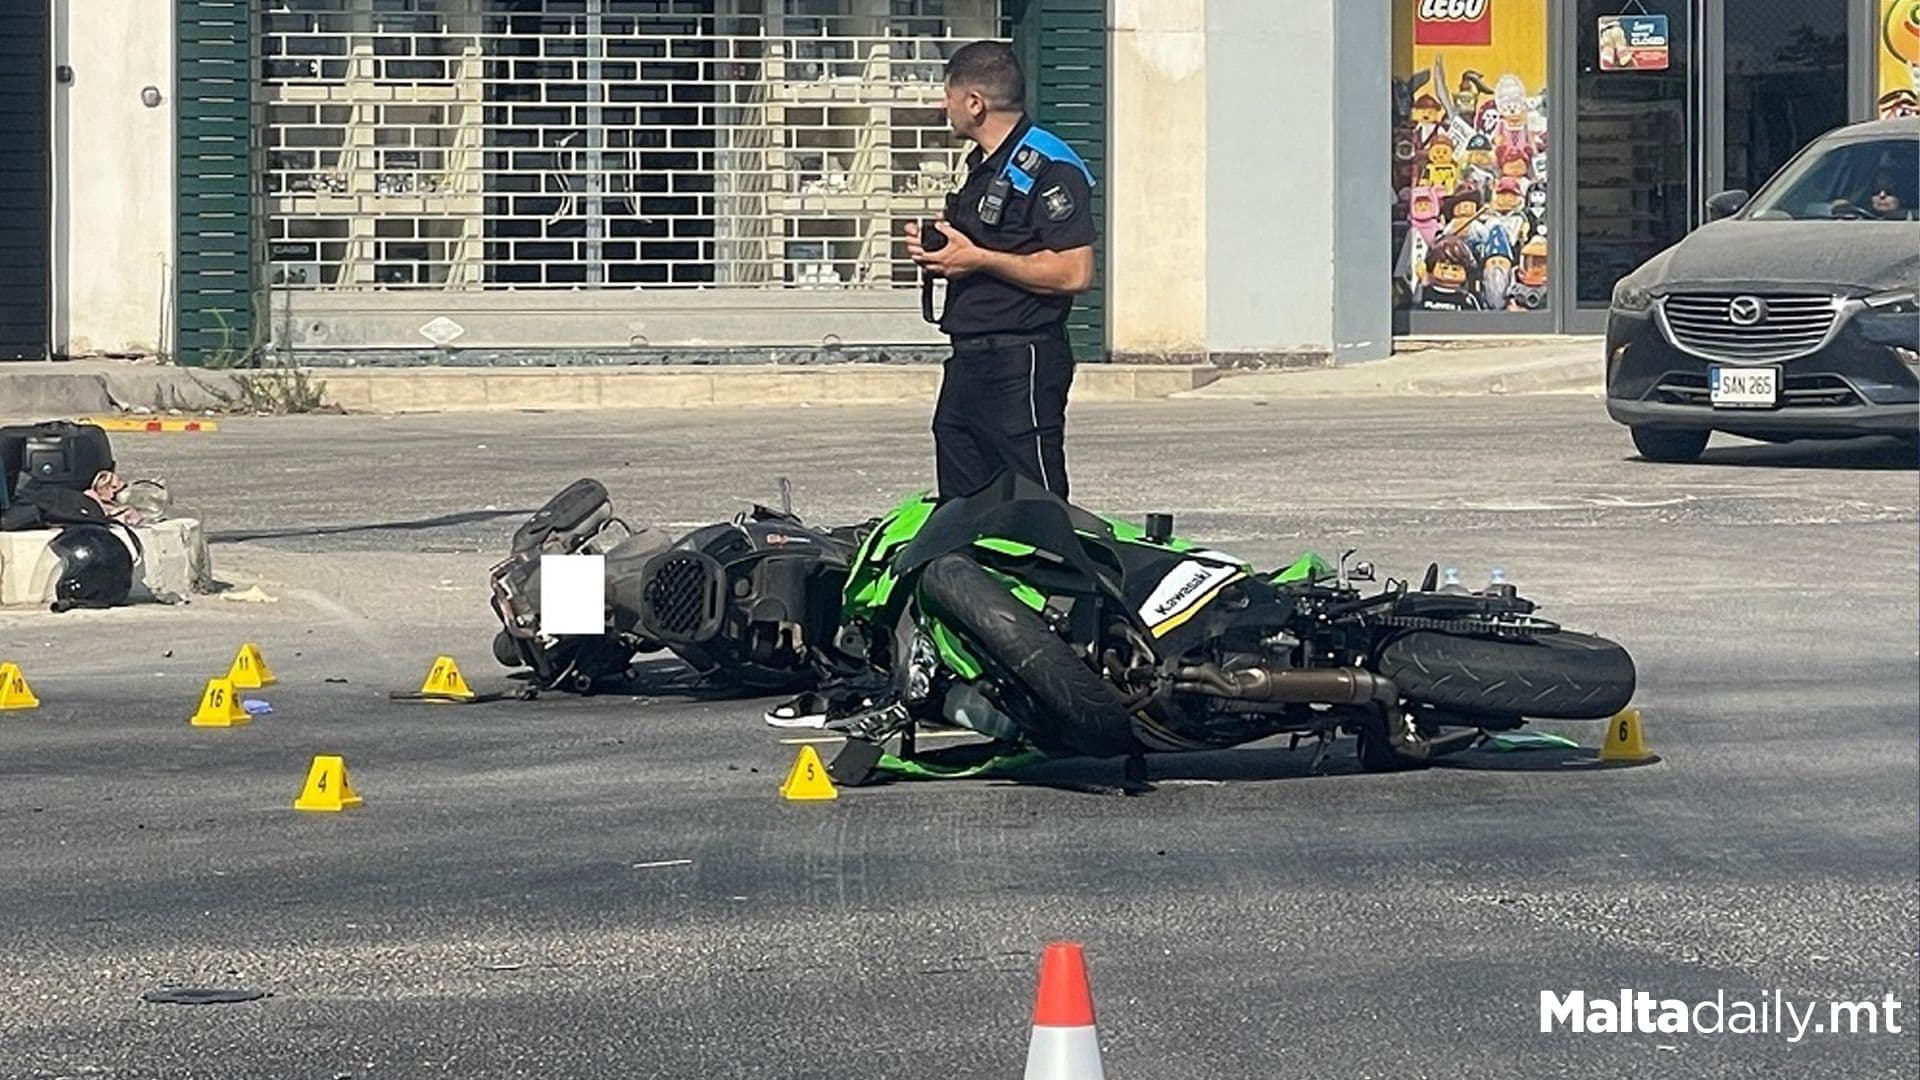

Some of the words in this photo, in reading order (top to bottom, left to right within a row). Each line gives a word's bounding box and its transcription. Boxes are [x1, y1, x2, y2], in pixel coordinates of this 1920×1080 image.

[1420, 0, 1486, 19] LEGO
[273, 244, 310, 254] CASIO
[1723, 375, 1746, 394] SAN
[1749, 375, 1772, 394] 265
[1154, 568, 1213, 616] Kawasaki
[446, 671, 457, 687] 17
[209, 688, 223, 708] 16
[1619, 720, 1629, 742] 6
[317, 769, 328, 793] 4
[807, 763, 815, 781] 5
